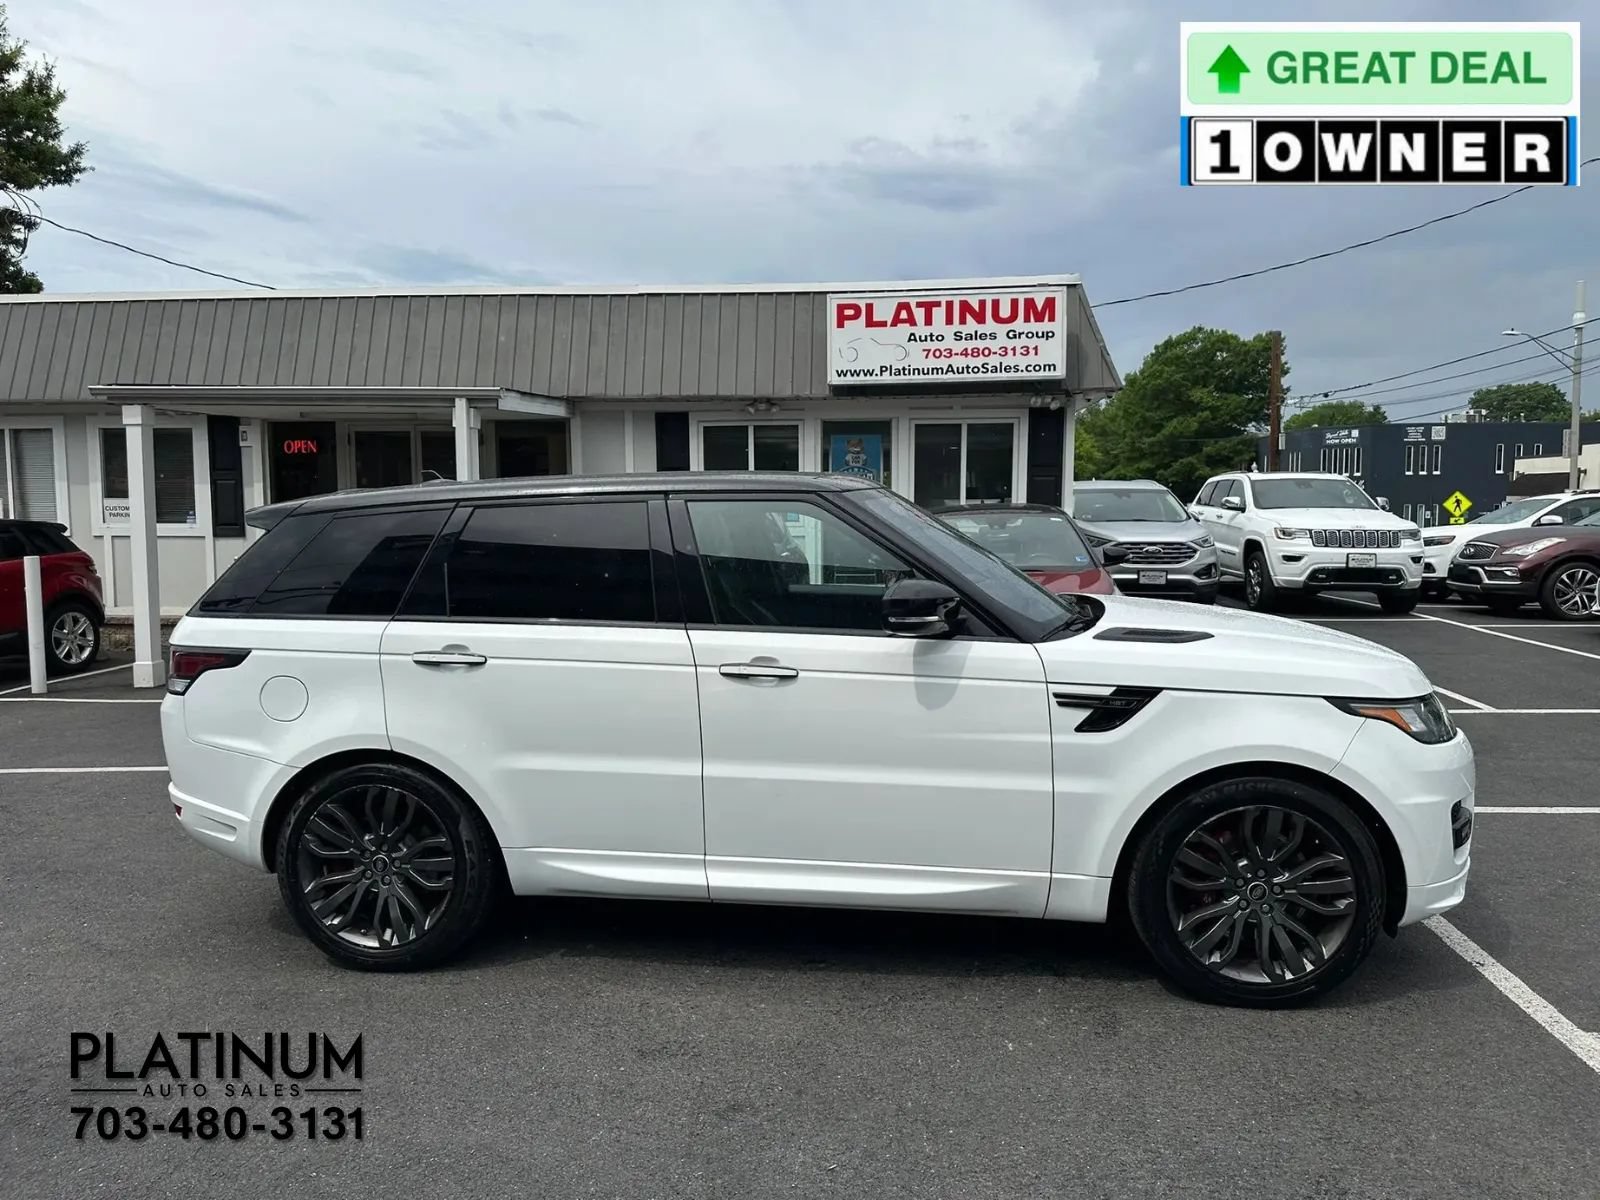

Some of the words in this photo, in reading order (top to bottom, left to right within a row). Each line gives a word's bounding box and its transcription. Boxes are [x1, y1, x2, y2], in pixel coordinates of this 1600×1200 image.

[836, 296, 1057, 329] PLATINUM
[907, 332, 945, 343] Auto
[953, 330, 997, 342] Sales
[1006, 329, 1055, 341] Group
[922, 345, 1039, 359] 703-480-3131
[835, 361, 1057, 378] www.PlatinumAutoSales.com
[284, 440, 317, 454] OPEN
